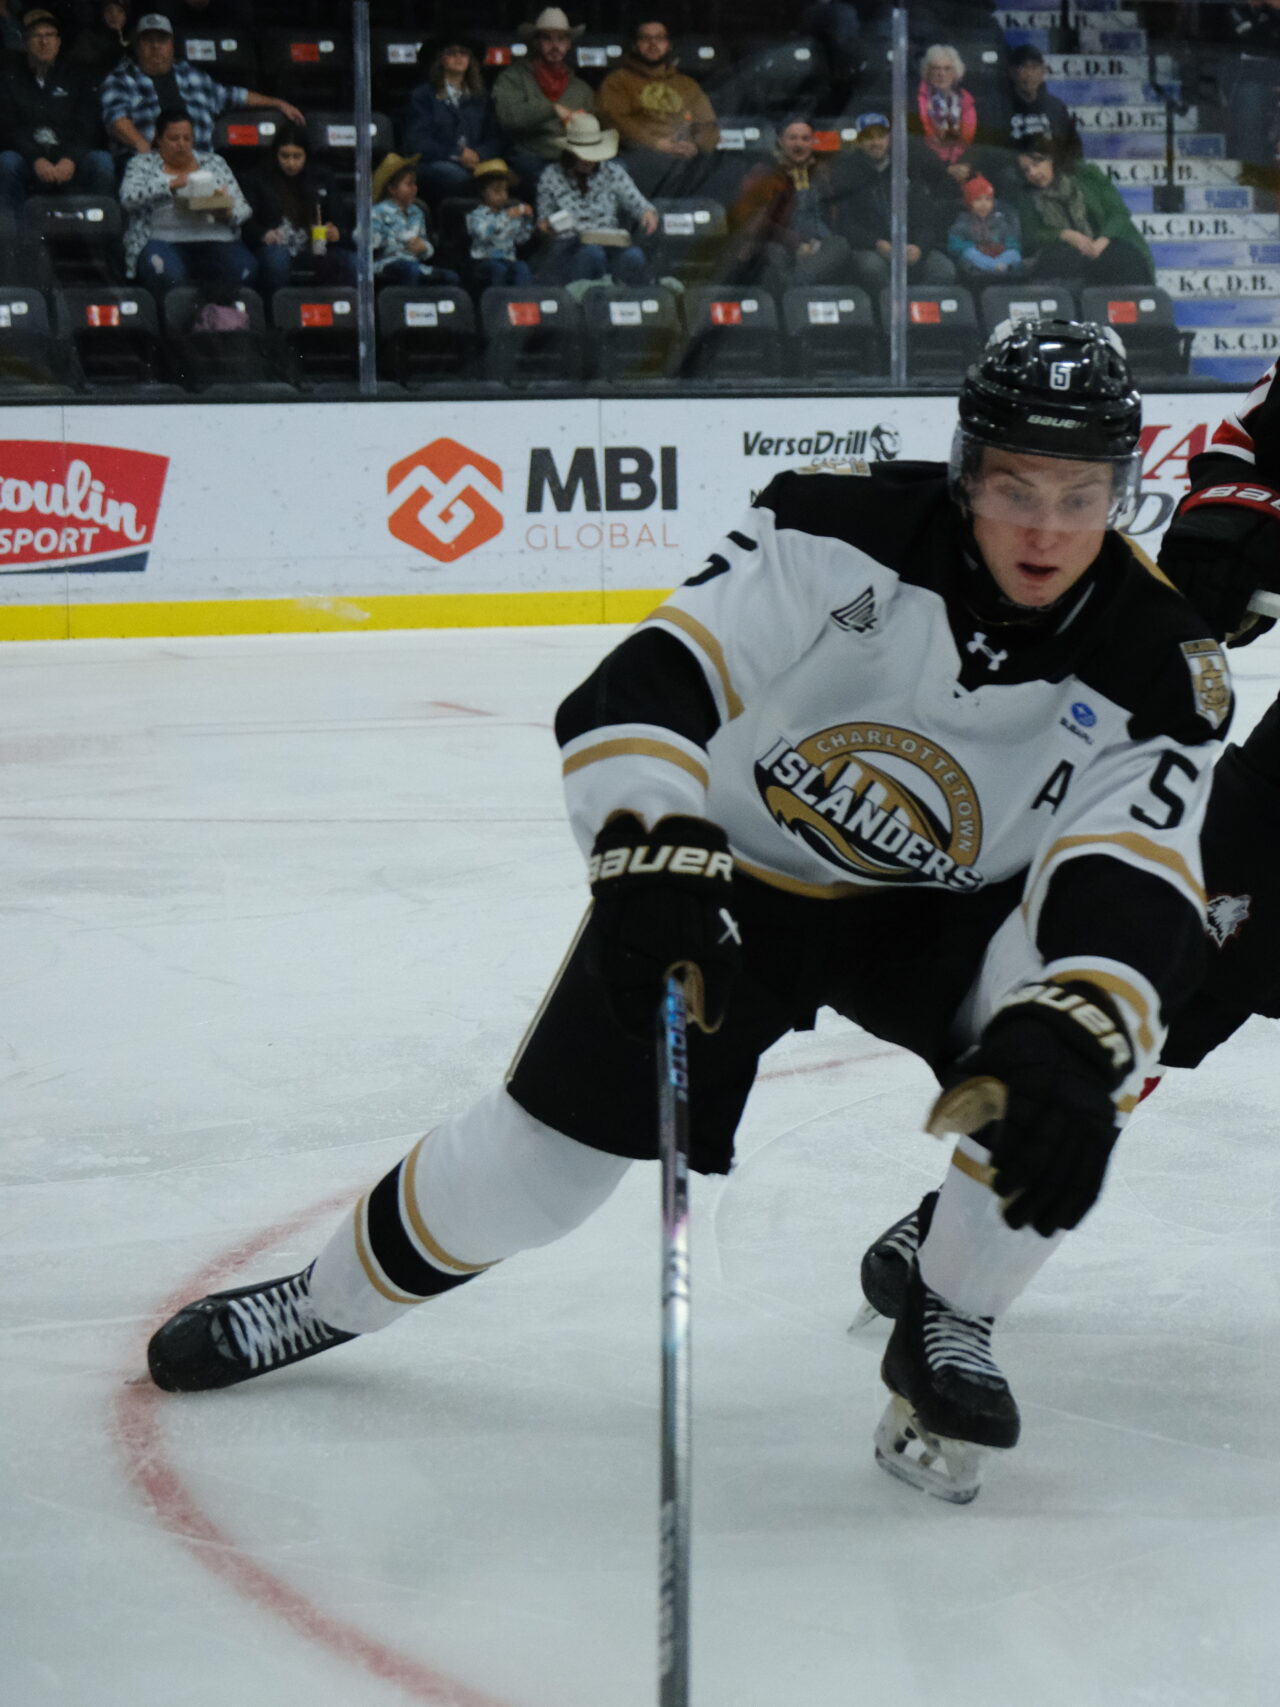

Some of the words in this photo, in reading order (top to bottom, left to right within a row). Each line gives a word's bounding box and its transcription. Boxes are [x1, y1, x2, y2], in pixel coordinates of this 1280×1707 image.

[1047, 58, 1128, 76] .C.D.B.
[1106, 164, 1198, 182] K.C.DB.
[1142, 218, 1236, 237] K.C.D.B.
[1179, 274, 1274, 293] K.C.D.B.
[1050, 362, 1071, 391] 5
[743, 430, 867, 456] VersaDrill
[526, 445, 678, 513] MBI
[0, 459, 147, 542] oulin
[525, 522, 680, 551] GLOBAL
[815, 729, 977, 853] CHARLOTTETOWN
[1030, 759, 1075, 816] A
[1129, 749, 1200, 830] 5
[756, 736, 984, 893] ISLANDERS
